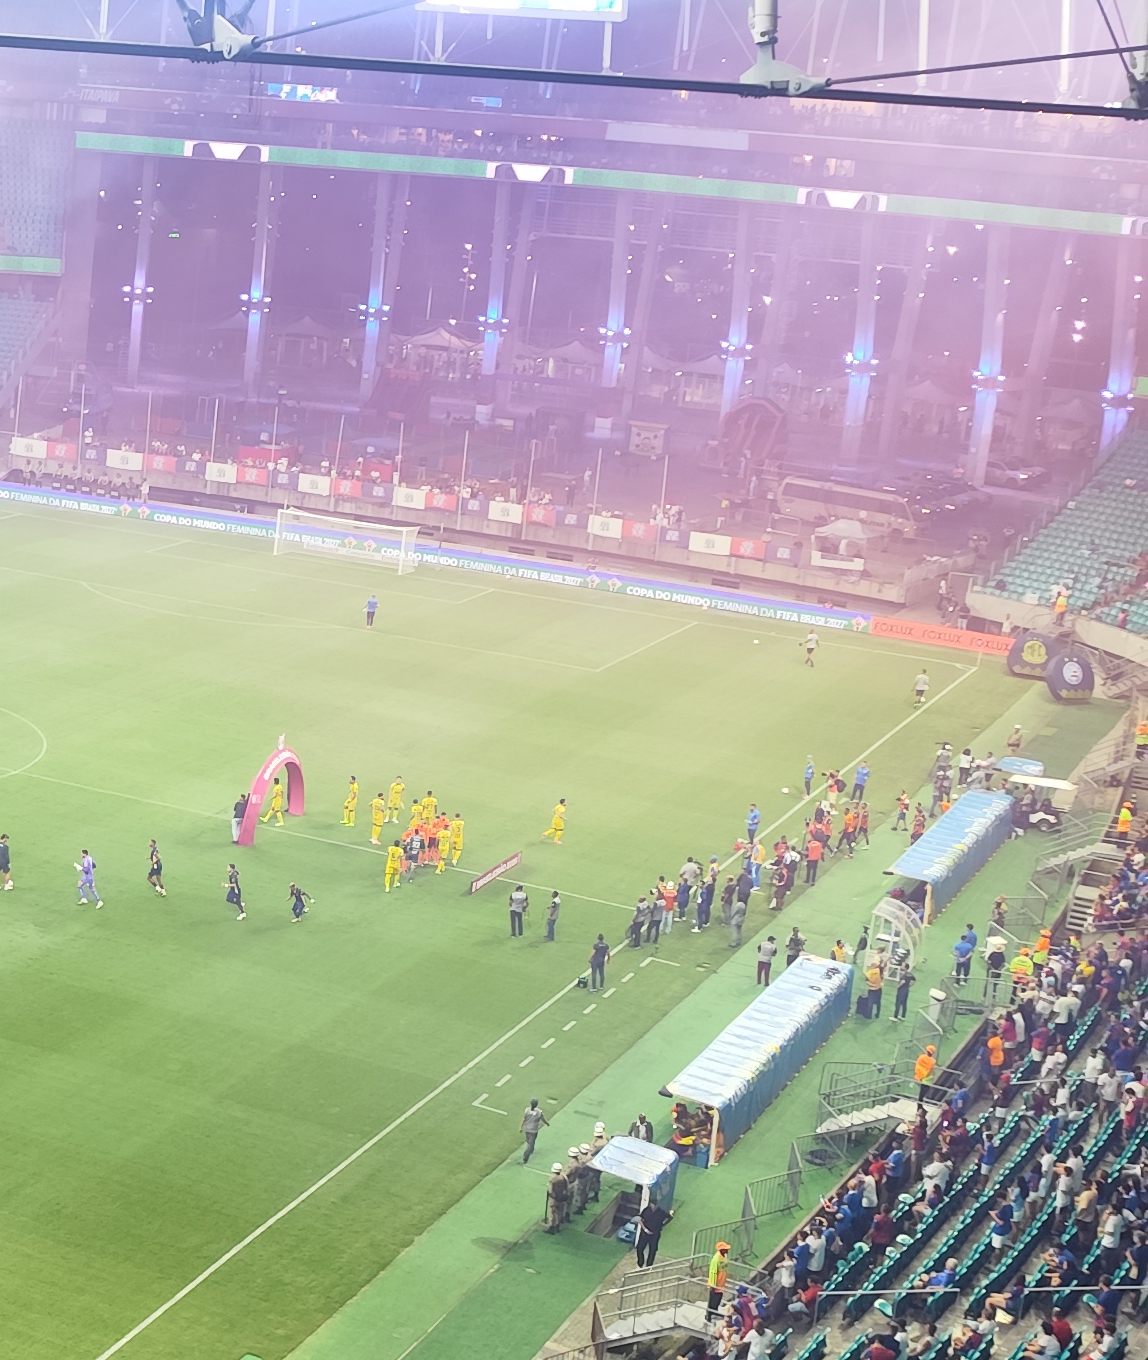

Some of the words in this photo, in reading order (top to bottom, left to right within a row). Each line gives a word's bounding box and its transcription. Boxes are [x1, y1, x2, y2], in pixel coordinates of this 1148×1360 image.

[10, 492, 48, 504] FEMININA
[49, 497, 60, 507] DA
[61, 499, 79, 510] FIFA
[153, 513, 178, 525] COPA
[178, 516, 192, 527] DO
[192, 519, 226, 531] MUNDO
[226, 524, 267, 538] FEMININA
[282, 531, 301, 542] FIFA
[407, 551, 422, 561] DO
[422, 553, 458, 567] MUNDO
[458, 559, 503, 575] FEMININA
[503, 565, 518, 577] DA
[517, 568, 540, 581] FIFA
[539, 572, 566, 586] BRASIL
[626, 586, 654, 598] COPA
[654, 590, 671, 601] DO
[672, 593, 711, 607] MUNDO
[711, 599, 759, 616] FEMININA
[759, 607, 775, 618] DA
[776, 609, 799, 622] FIFA
[799, 614, 826, 627] BRASIL
[873, 621, 914, 637] FOXLUX
[921, 629, 962, 644] FOXLUX
[969, 636, 1010, 652] FOXLUX
